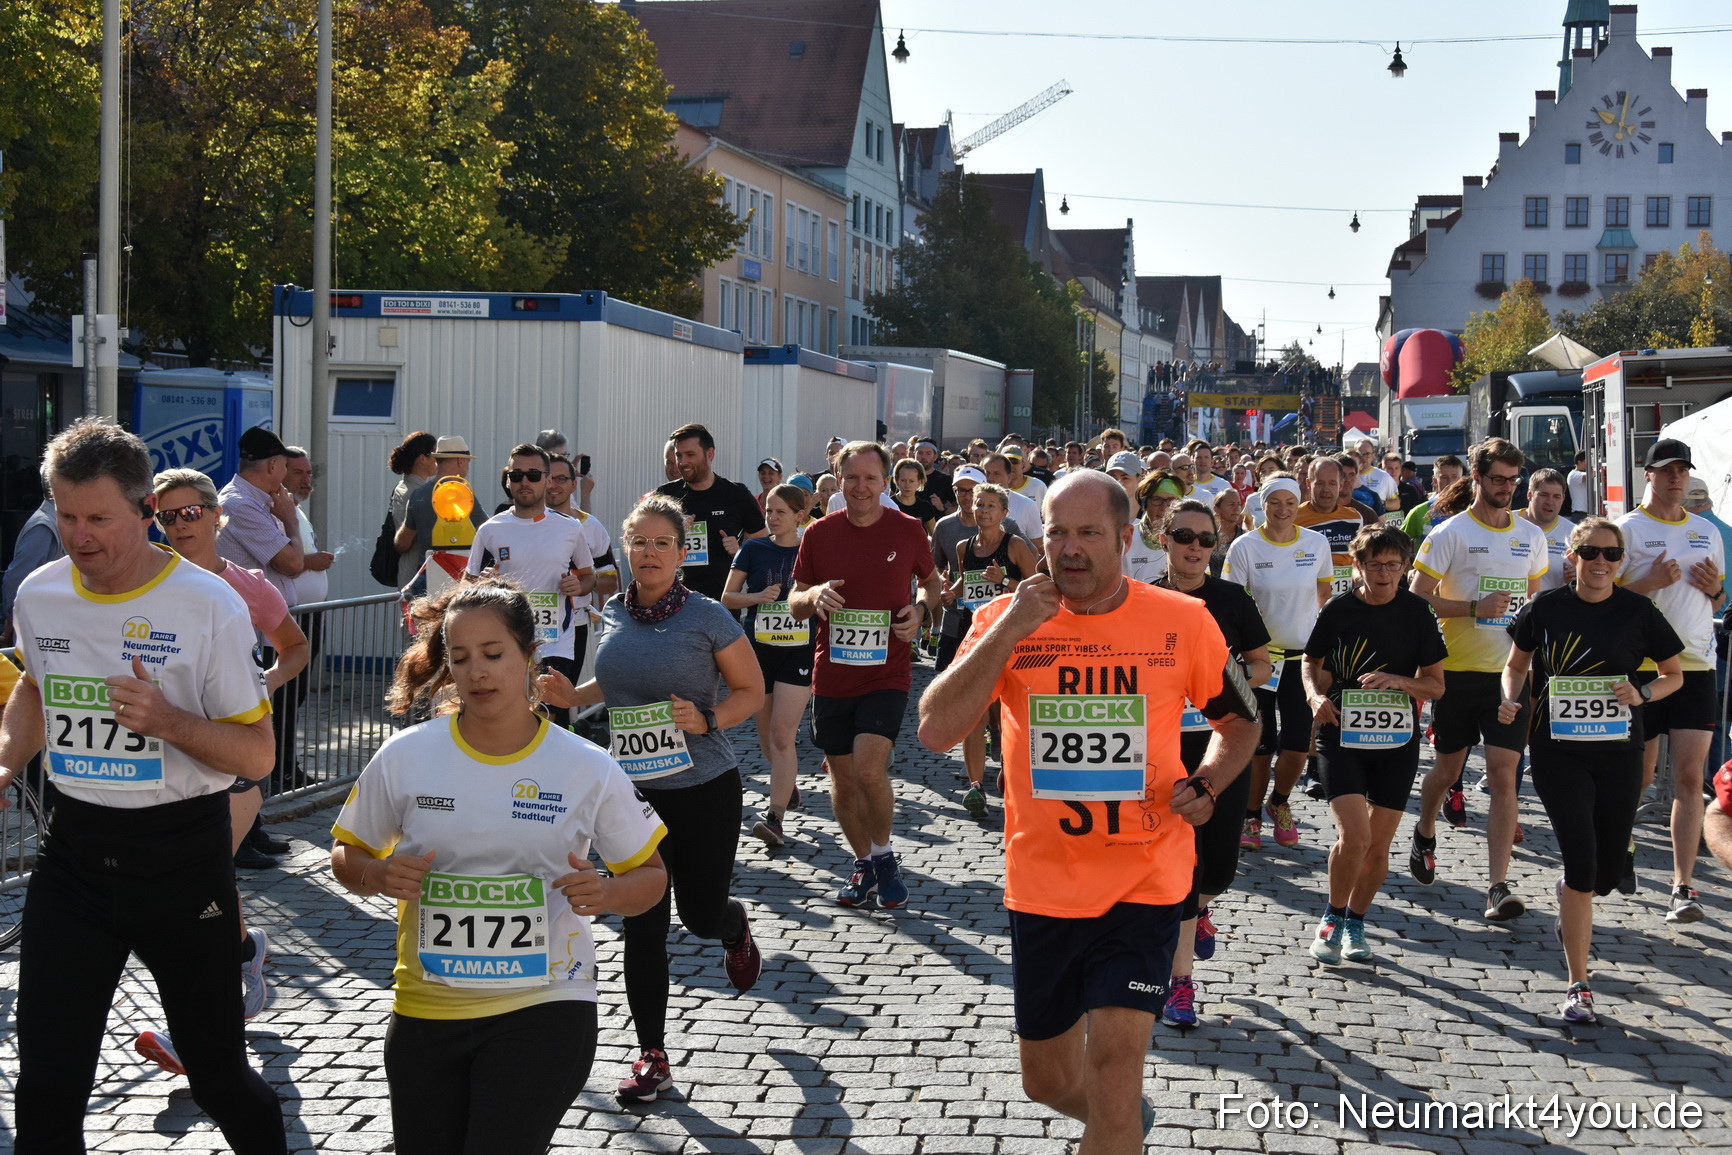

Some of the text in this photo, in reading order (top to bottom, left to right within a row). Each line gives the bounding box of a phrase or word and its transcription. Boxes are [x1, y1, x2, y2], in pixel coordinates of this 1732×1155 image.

[162, 395, 184, 403] 08141
[191, 396, 205, 405] 536
[207, 398, 216, 406] 80
[1224, 397, 1263, 406] START
[968, 584, 1002, 600] 2645
[762, 616, 803, 630] 1244
[834, 611, 885, 625] BOCK
[124, 621, 174, 641] 20 JAHRE
[835, 628, 880, 646] 2271
[36, 637, 70, 649] BOCK
[123, 640, 181, 654] Neumarkter
[1014, 644, 1042, 654] URBAN
[1045, 644, 1071, 653] SPORT
[1075, 644, 1099, 653] VIBES
[121, 652, 167, 666] Stadtlauf
[842, 650, 873, 659] FRANK
[1148, 657, 1176, 667] SPEED
[1348, 692, 1404, 706] BOCK
[1037, 700, 1135, 722] BOCK
[1559, 699, 1620, 718] 2595
[613, 705, 672, 727] BOCK
[1350, 711, 1404, 729] 2592
[1572, 724, 1607, 733] JULIA
[617, 728, 676, 756] 2004
[1360, 734, 1394, 742] MARIA
[1042, 732, 1131, 764] 2832
[64, 759, 137, 777] ROLAND
[621, 756, 683, 772] FRANZISKA
[515, 784, 561, 801] 20 JAHRE
[417, 796, 455, 808] BOCK
[513, 800, 567, 813] Neumarkter
[512, 811, 556, 824] Stadtlauf
[429, 879, 535, 904] BOCK
[200, 910, 222, 919] adidas
[433, 914, 533, 948] 2172
[441, 959, 523, 974] TAMARA
[1128, 981, 1160, 994] CRAFT
